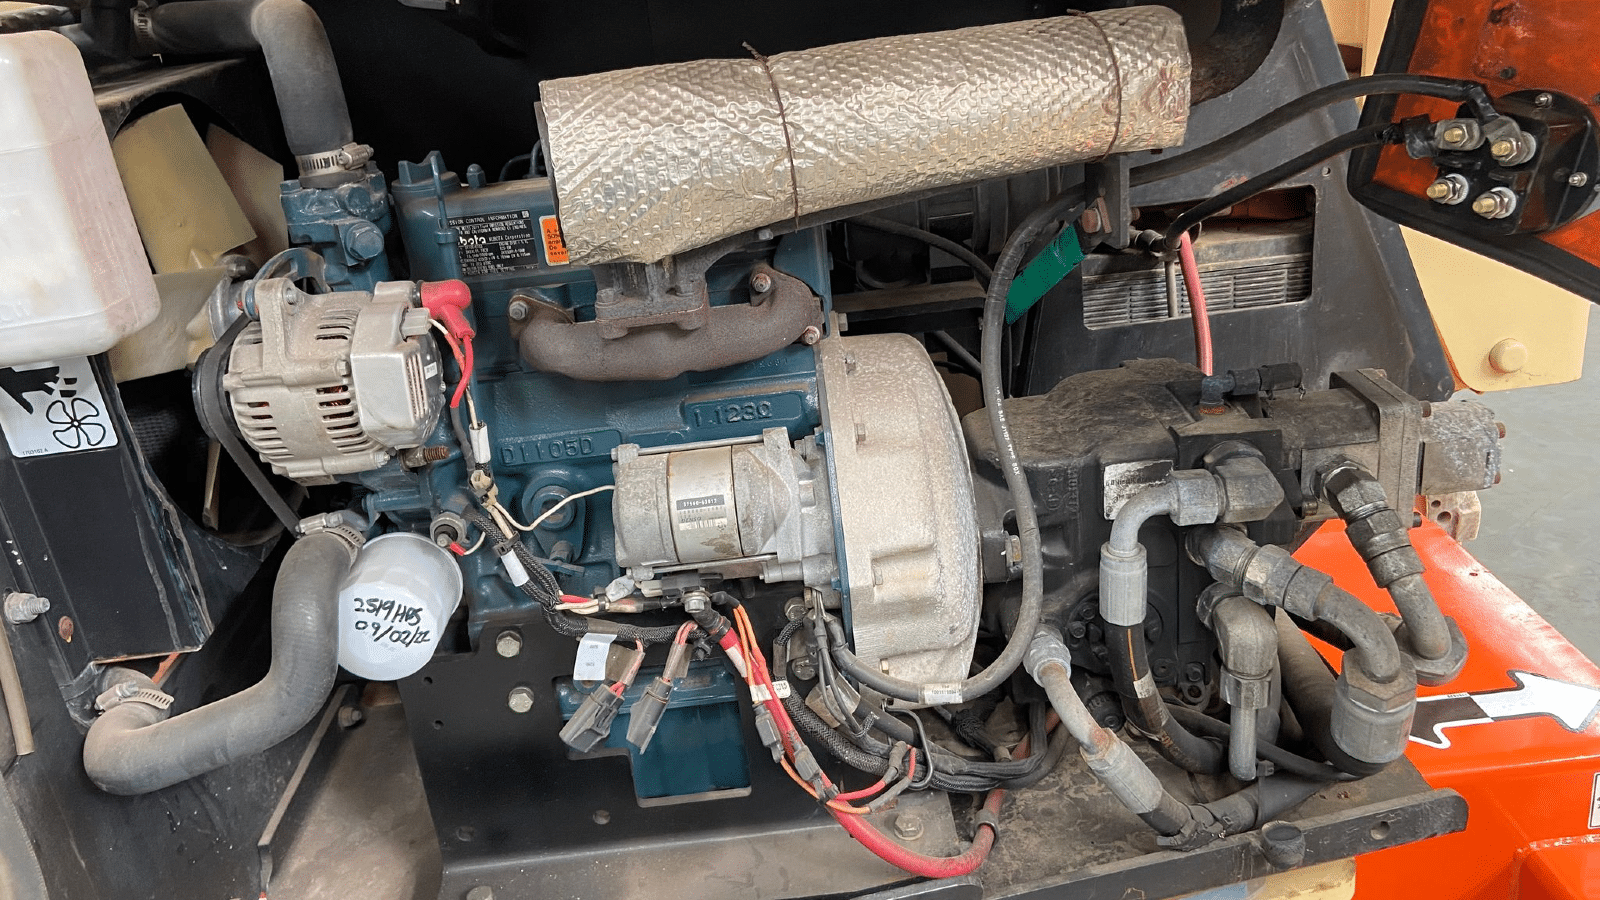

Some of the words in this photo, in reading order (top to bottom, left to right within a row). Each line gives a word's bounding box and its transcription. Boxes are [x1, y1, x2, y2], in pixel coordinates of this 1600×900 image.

[488, 213, 518, 221] INFORMATION
[459, 235, 486, 246] bota
[499, 436, 594, 467] D1105D
[1007, 443, 1016, 459] TYPE
